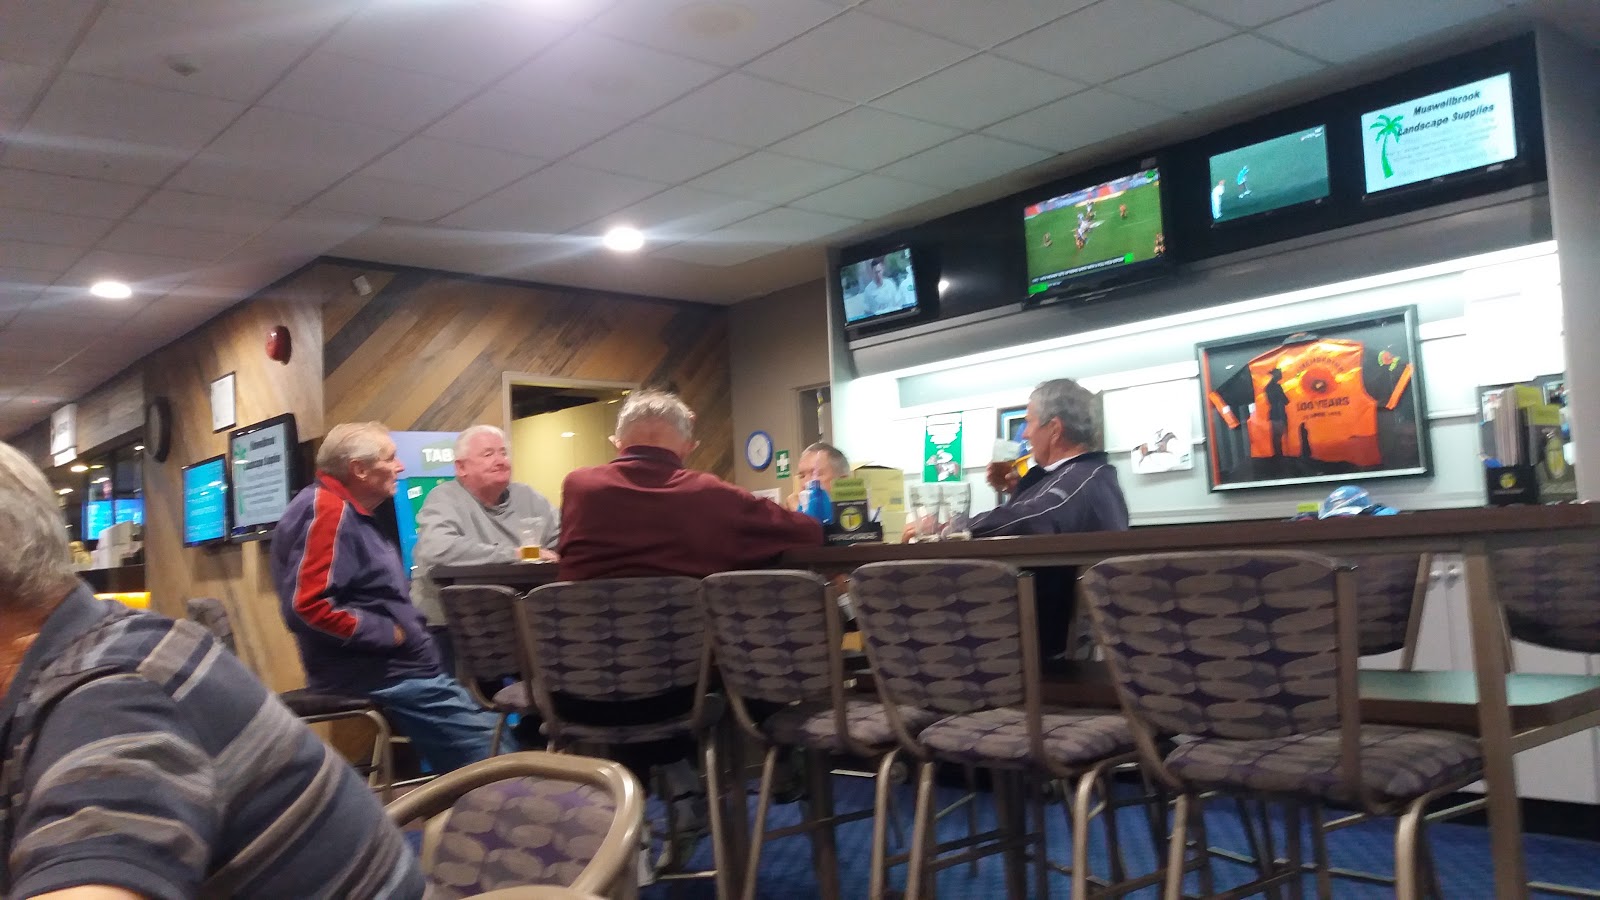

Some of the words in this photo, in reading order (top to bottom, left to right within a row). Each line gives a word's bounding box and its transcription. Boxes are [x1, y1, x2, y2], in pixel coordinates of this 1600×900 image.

[1413, 90, 1480, 116] Muswellbrook
[1397, 117, 1449, 137] Landscape
[1452, 103, 1495, 122] Supplies
[1296, 401, 1314, 412] 100
[1315, 397, 1350, 410] YEARS
[422, 448, 455, 462] TAB
